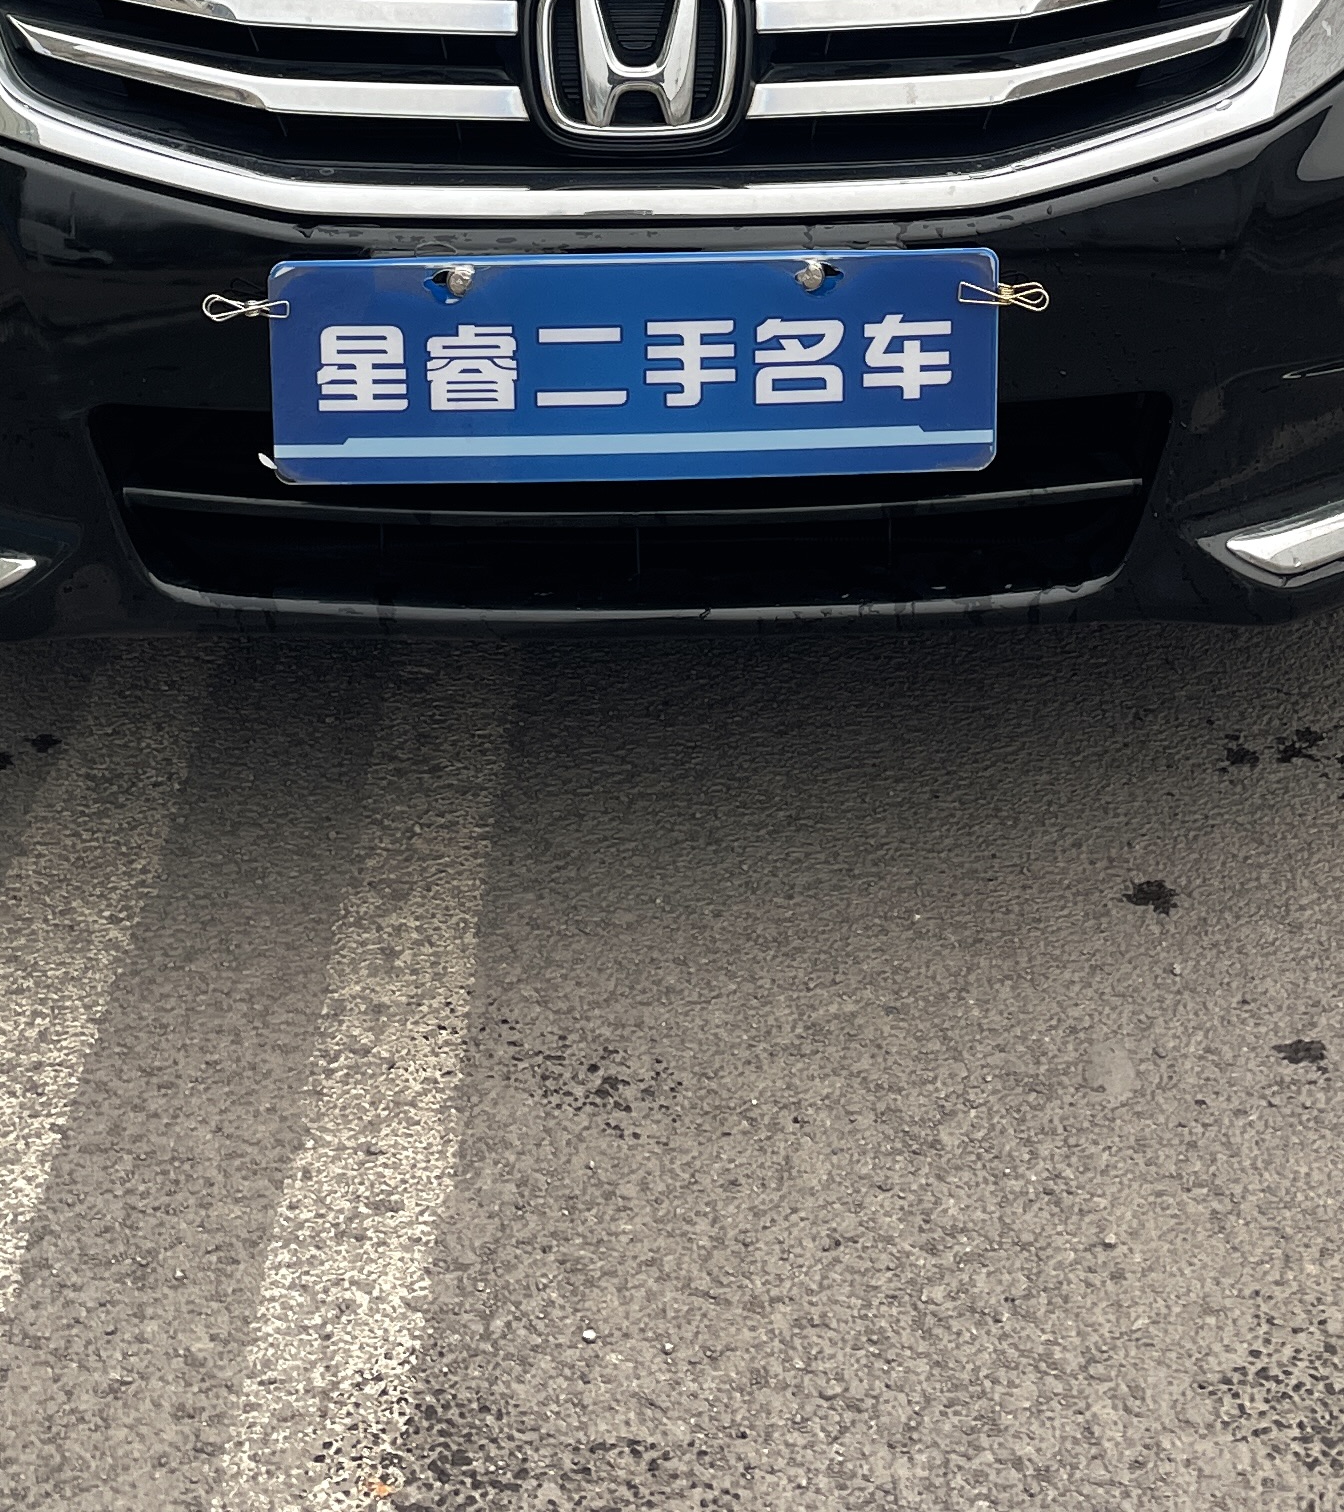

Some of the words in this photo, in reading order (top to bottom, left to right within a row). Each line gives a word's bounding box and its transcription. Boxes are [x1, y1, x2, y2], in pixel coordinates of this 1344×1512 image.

[316, 313, 954, 413] 星睿二手名车
